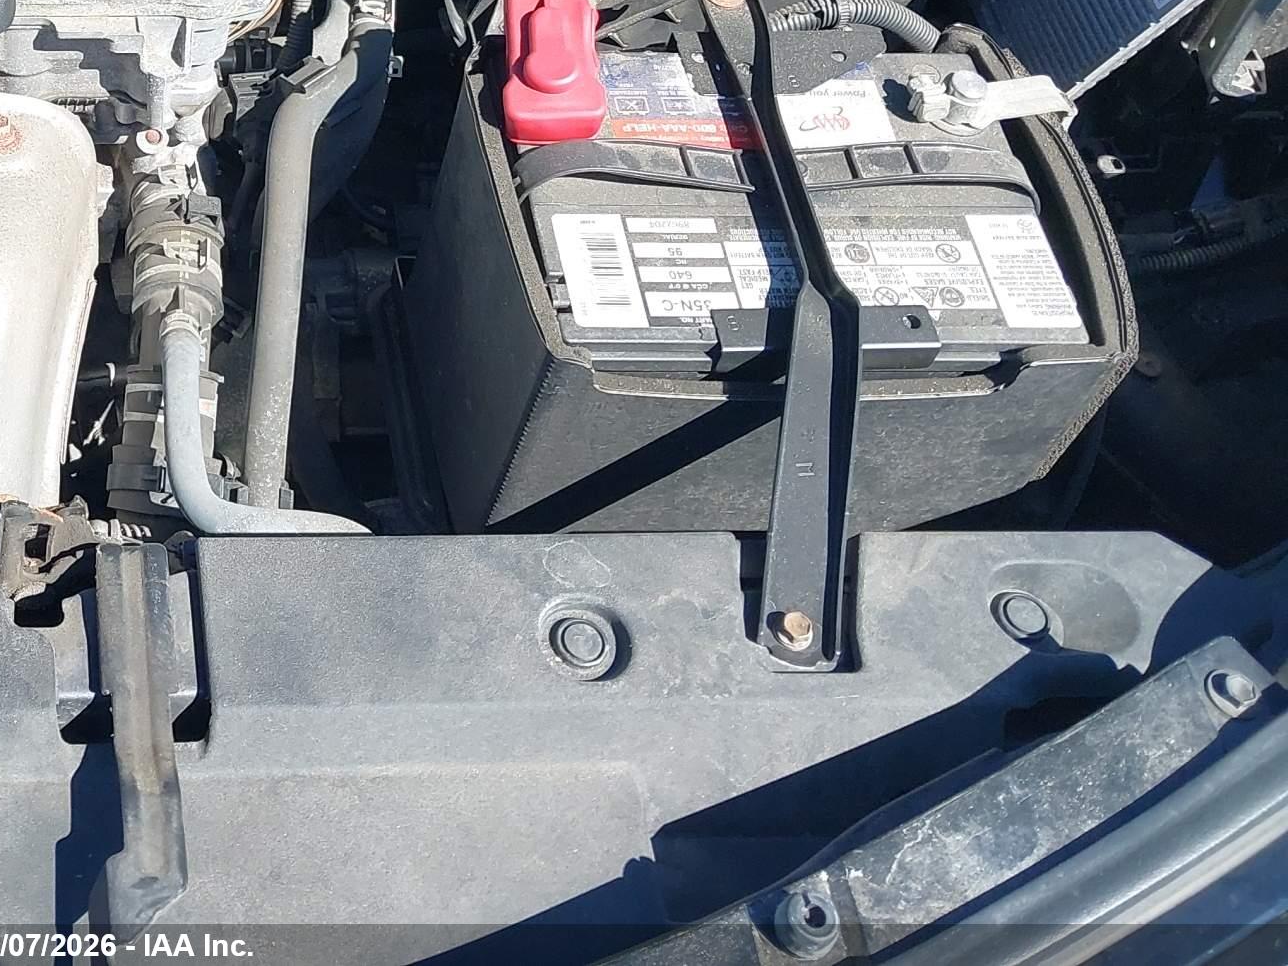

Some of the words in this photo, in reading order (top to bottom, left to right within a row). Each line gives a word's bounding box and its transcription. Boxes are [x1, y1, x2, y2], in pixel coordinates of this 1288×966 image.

[808, 88, 830, 99] you
[830, 89, 867, 99] Power
[667, 247, 683, 256] 95
[668, 270, 693, 280] 640
[690, 282, 709, 290] CCA
[660, 299, 712, 312] 35N-C
